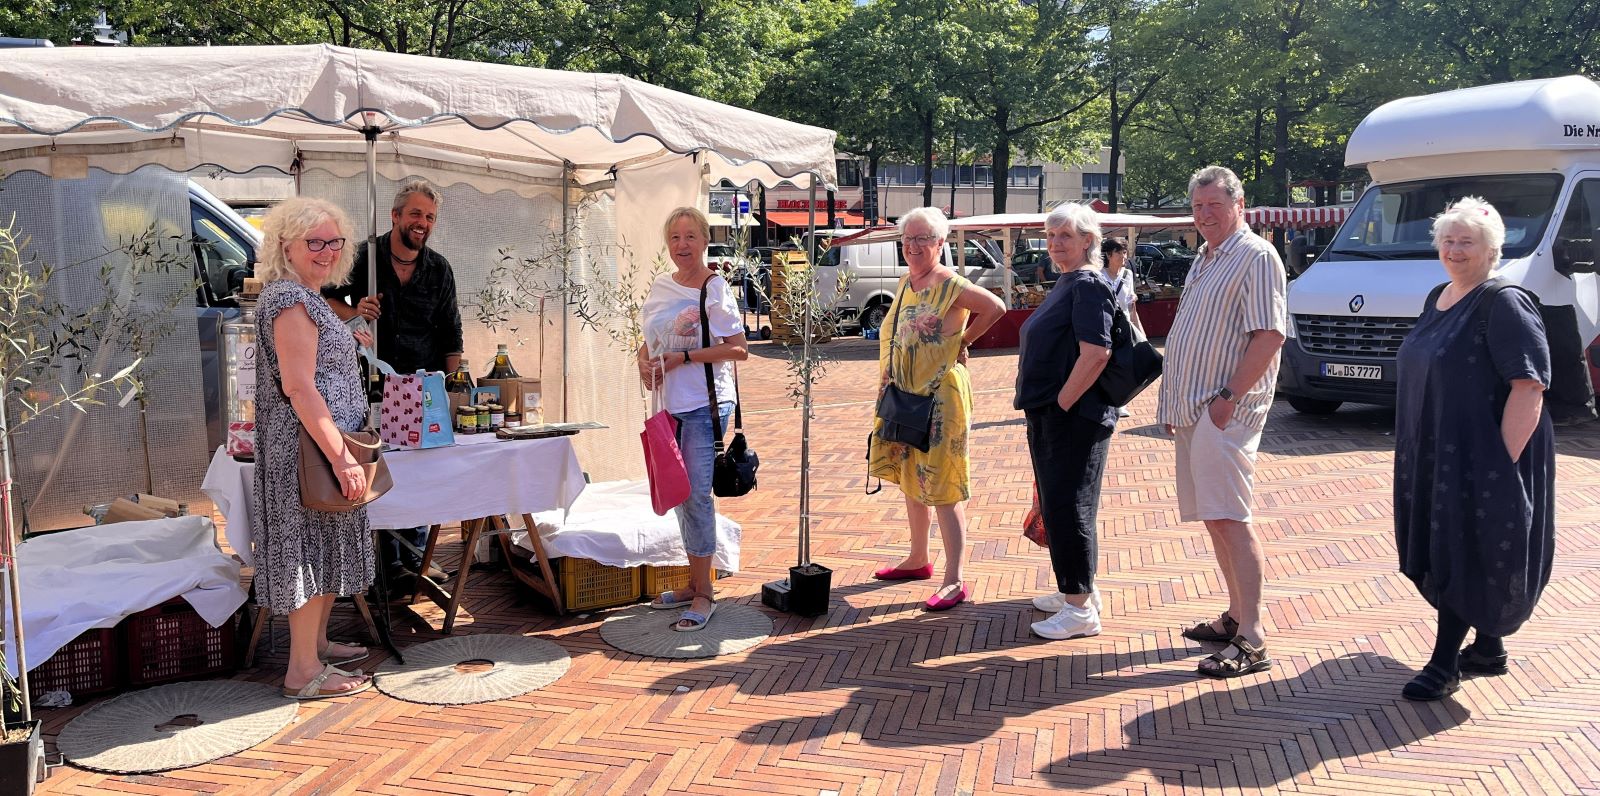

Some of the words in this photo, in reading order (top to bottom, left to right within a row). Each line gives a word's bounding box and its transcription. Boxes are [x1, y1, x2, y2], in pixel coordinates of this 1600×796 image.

[1563, 124, 1584, 136] Die
[1586, 124, 1600, 137] Nr
[1327, 365, 1337, 375] WL
[1344, 365, 1355, 376] DS
[1357, 366, 1380, 378] 7777
